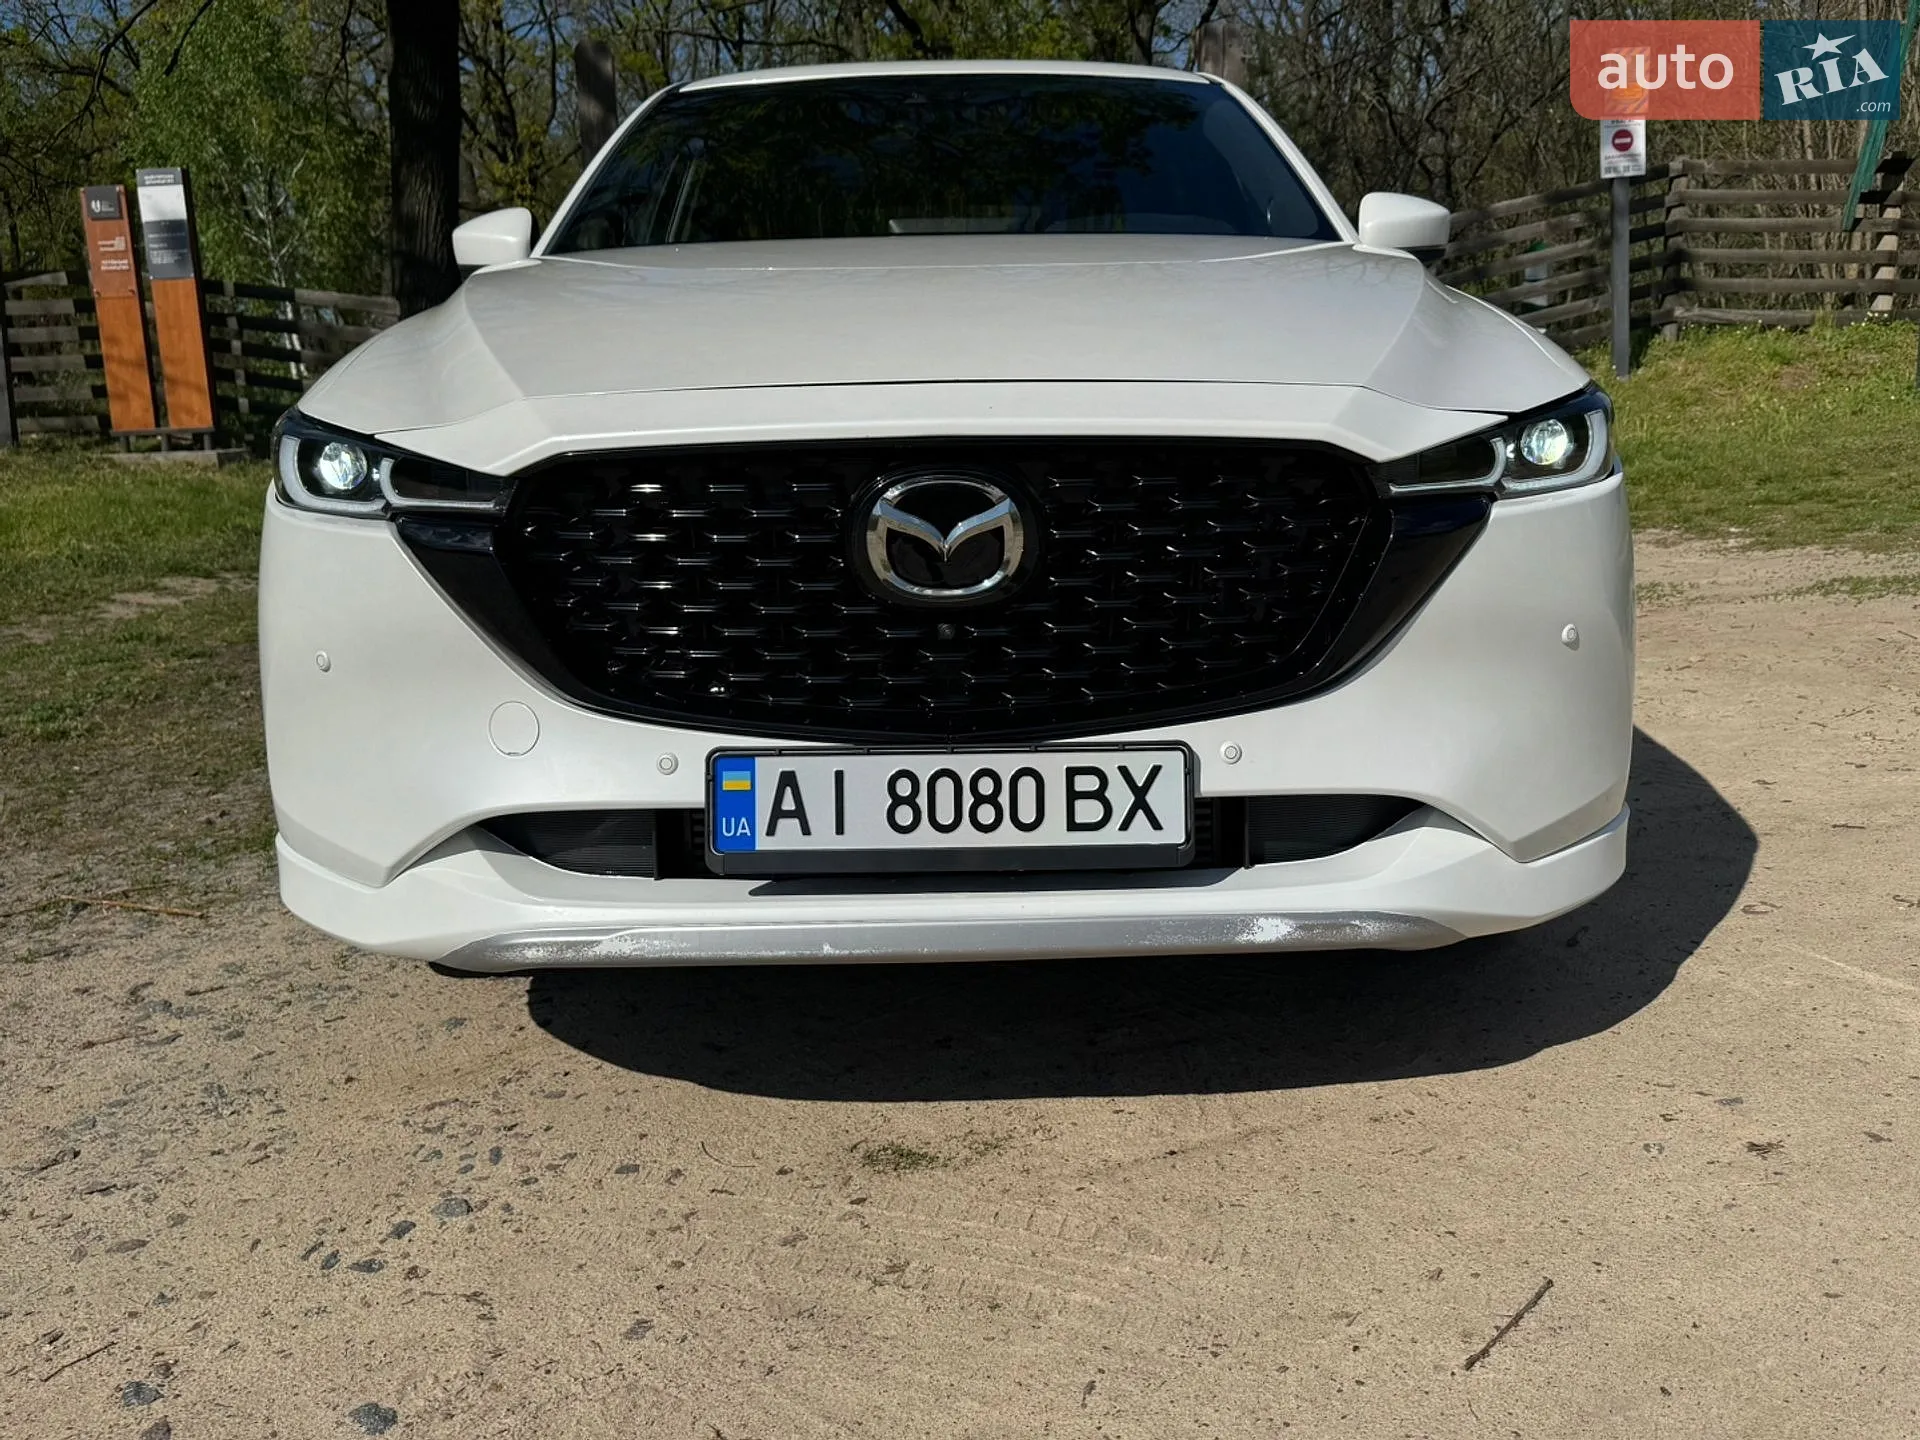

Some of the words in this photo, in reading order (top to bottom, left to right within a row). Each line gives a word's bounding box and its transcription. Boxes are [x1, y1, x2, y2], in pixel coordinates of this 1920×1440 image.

[765, 768, 845, 836] AI
[886, 766, 1045, 834] 8080
[1065, 764, 1163, 832] BX
[722, 816, 751, 838] UA
